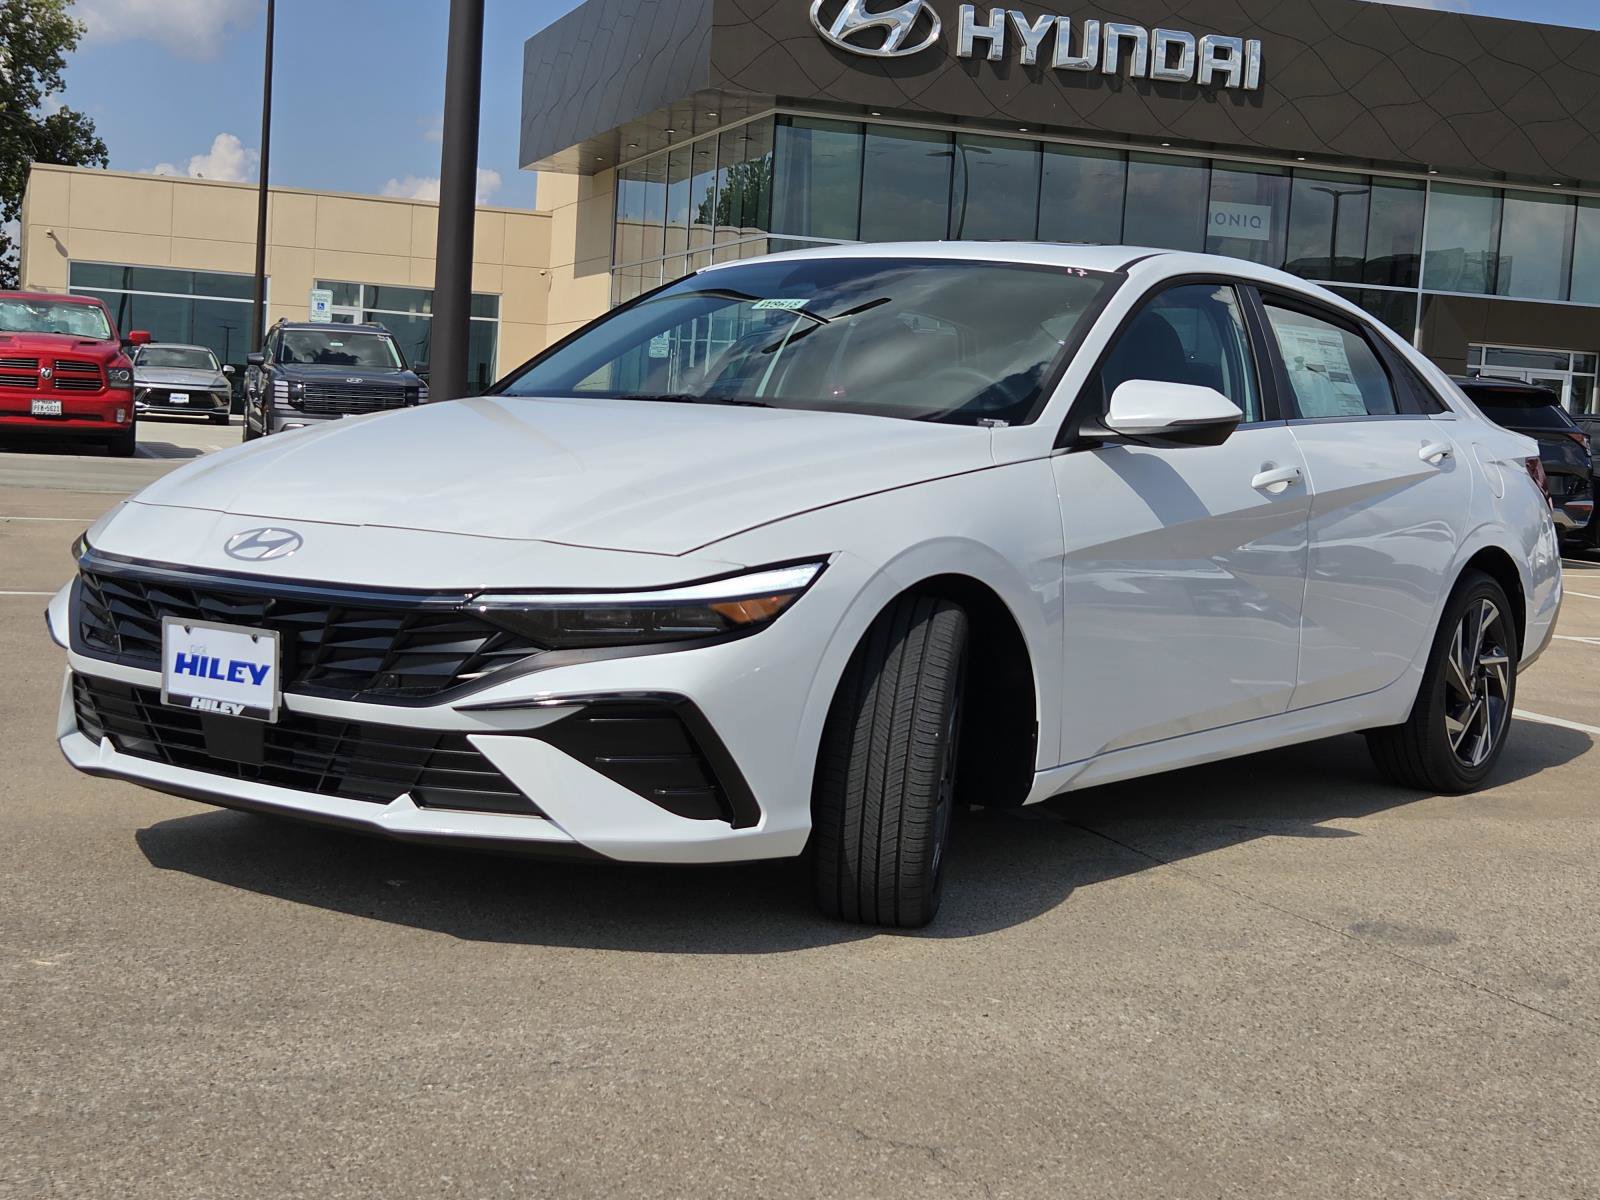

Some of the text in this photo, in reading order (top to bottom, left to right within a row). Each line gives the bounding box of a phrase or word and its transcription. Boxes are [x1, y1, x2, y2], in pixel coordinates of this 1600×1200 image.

[956, 4, 1262, 90] HYUNDAI
[1208, 211, 1262, 229] IONIQ
[174, 652, 271, 686] HILEY
[190, 697, 246, 715] HILEY
